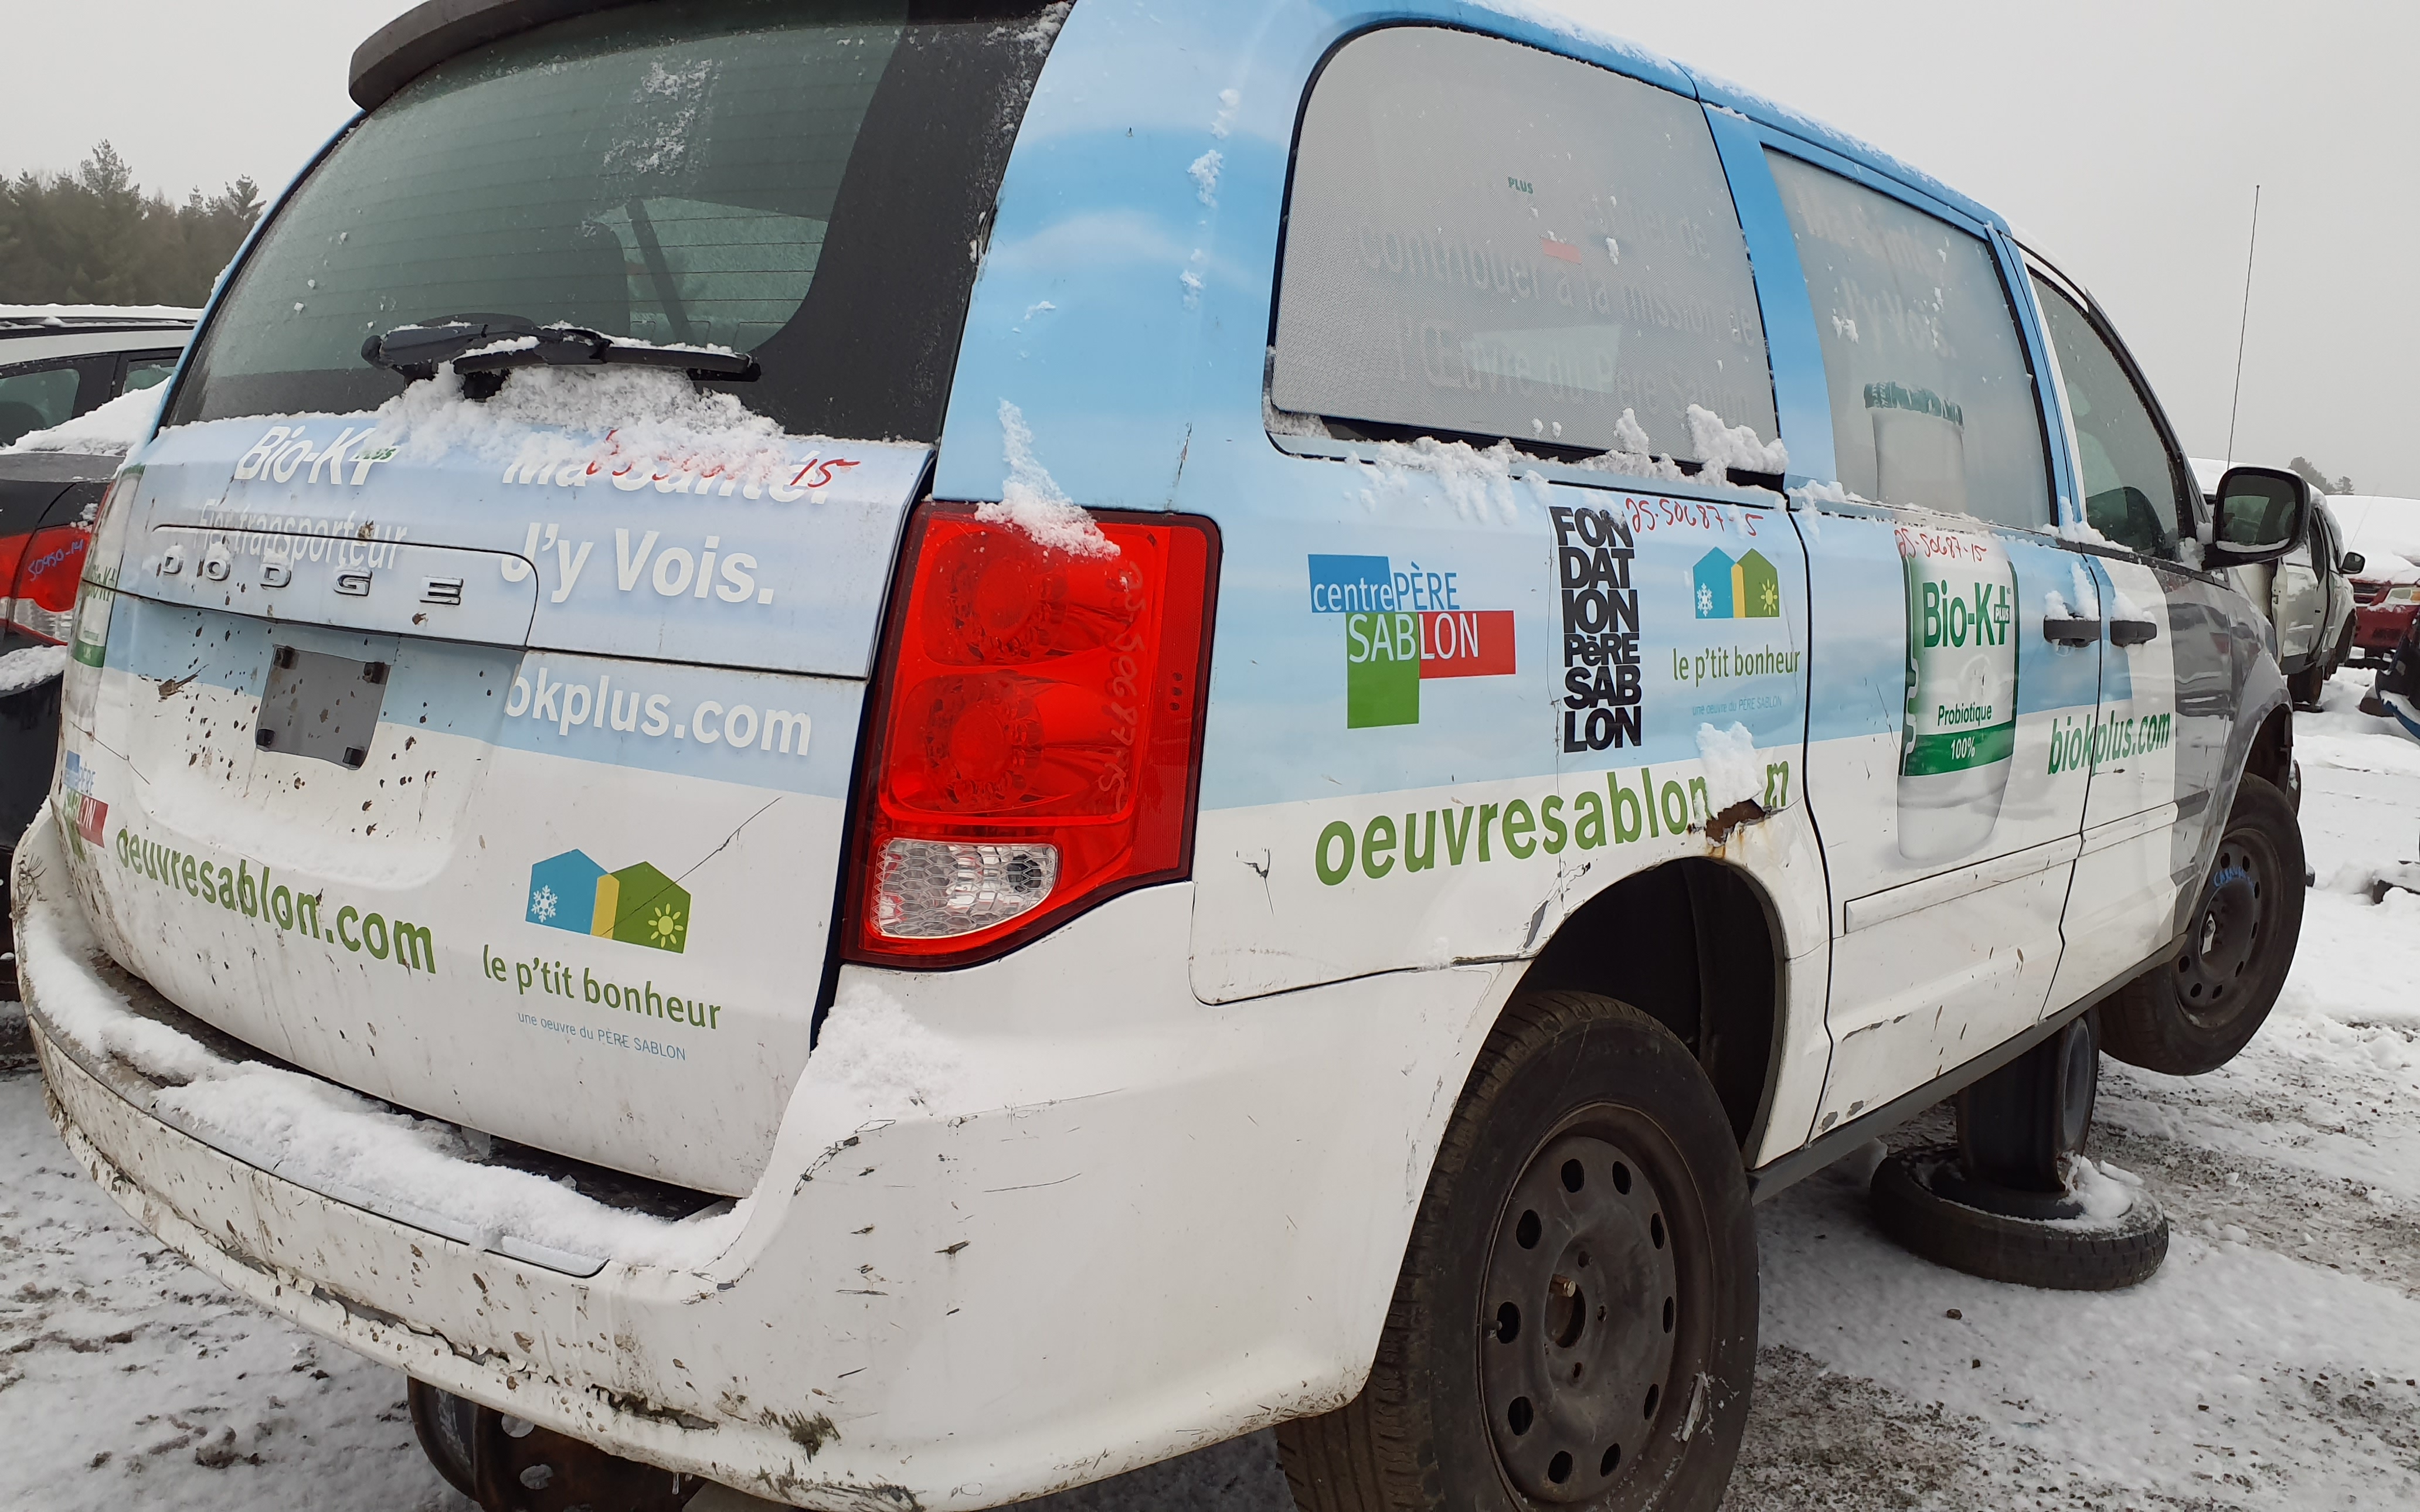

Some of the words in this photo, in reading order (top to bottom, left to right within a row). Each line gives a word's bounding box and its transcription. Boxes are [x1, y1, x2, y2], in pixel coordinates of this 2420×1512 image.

[1507, 176, 1534, 195] PLUS
[235, 503, 407, 573] transporteur
[1549, 506, 1634, 547] FON
[161, 553, 464, 606] DODGE
[501, 523, 594, 603] J'y
[616, 528, 774, 605] Vois.
[1558, 546, 1634, 588] DAT
[1562, 588, 1640, 634] ION
[1994, 606, 2010, 622] PLUS
[1349, 613, 1479, 663] SABLON
[1564, 665, 1642, 710] SAB
[1673, 648, 1689, 680] le
[1695, 646, 1729, 687] p'tit
[1734, 643, 1801, 677] bonheur
[1564, 705, 1641, 753] LON
[1692, 706, 1705, 716] une
[1707, 702, 1727, 715] oeuvre
[1729, 701, 1736, 711] du
[1757, 696, 1782, 710] SABLON
[1938, 702, 1991, 727] Probiotique
[1950, 737, 1975, 760] 100%
[2048, 710, 2171, 777] biokplus.com
[1316, 759, 1790, 886] oeuvresablonm
[116, 828, 436, 974] oeuvresablon.com
[483, 944, 507, 982] le
[516, 957, 575, 999] p'tit
[583, 967, 721, 1030] bonheur
[518, 1012, 537, 1026] une
[541, 1017, 576, 1036] oeuvre
[580, 1025, 594, 1040] du
[598, 1027, 630, 1048] PÈRE
[634, 1037, 686, 1061] SABLON
